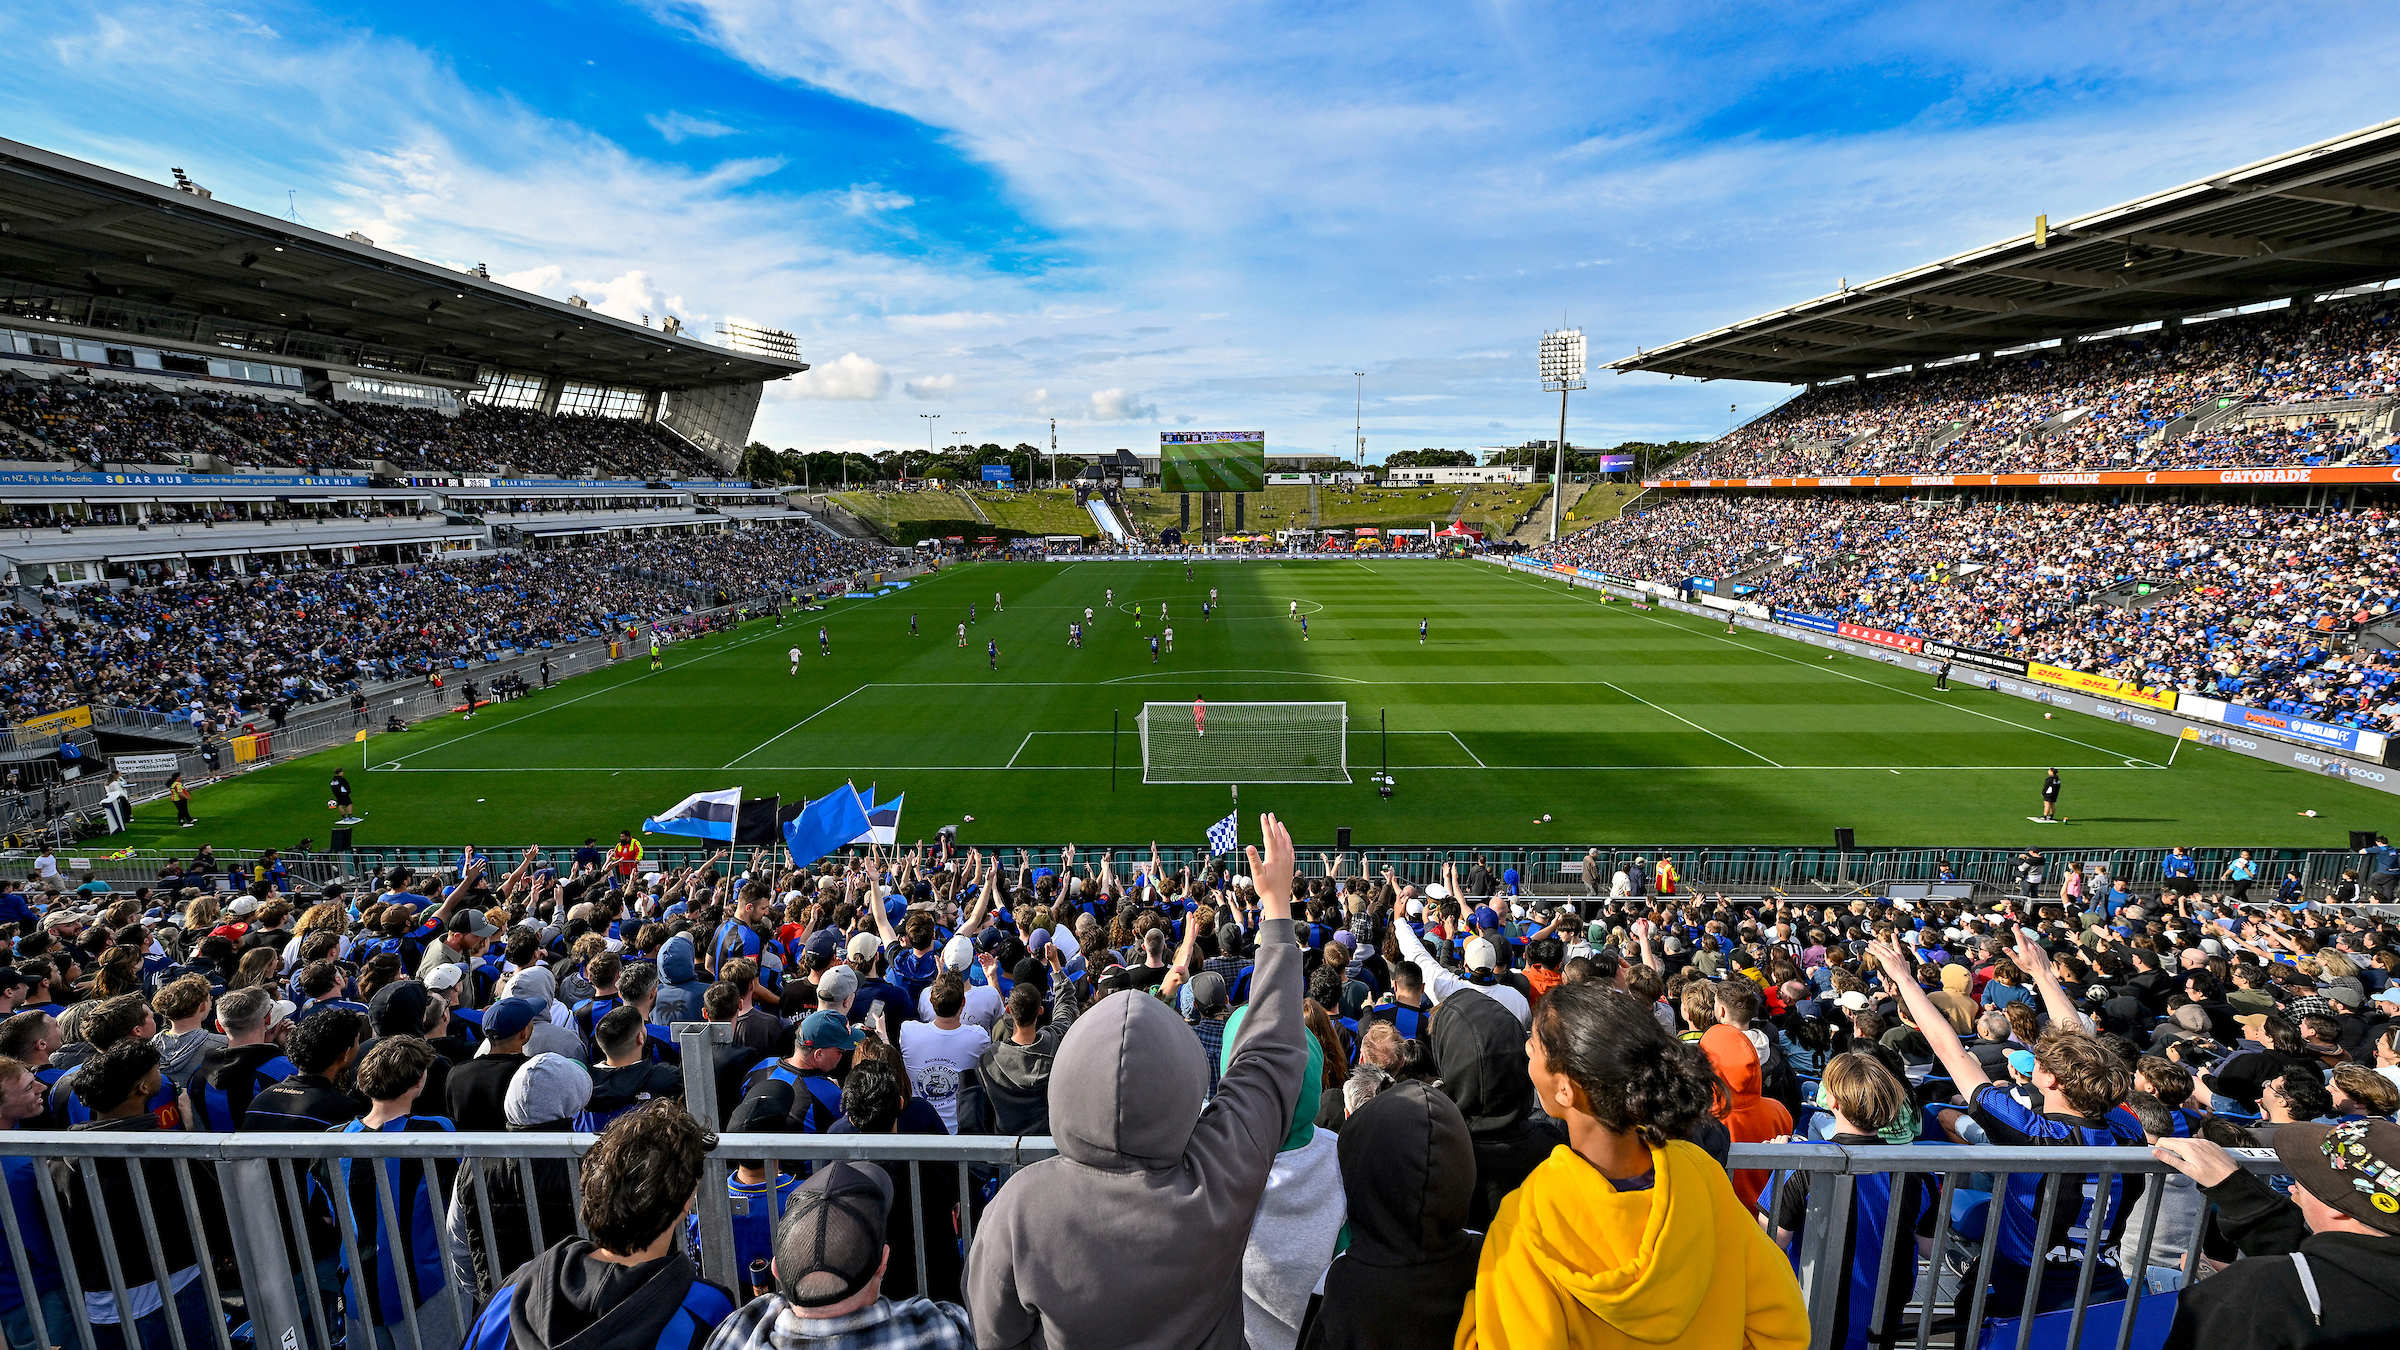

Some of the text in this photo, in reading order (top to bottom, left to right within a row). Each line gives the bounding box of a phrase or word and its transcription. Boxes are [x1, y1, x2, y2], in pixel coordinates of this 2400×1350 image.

[12, 475, 27, 483] NZ,
[29, 475, 41, 485] Fiji
[51, 475, 65, 483] the
[66, 475, 93, 483] Pacific
[158, 476, 182, 484] HUB
[192, 476, 210, 484] Score
[334, 478, 352, 486] HUB
[1746, 479, 1772, 487] GATORADE
[1818, 478, 1851, 486] GATORADE
[1874, 477, 1880, 486] G
[1911, 476, 1955, 486] GATORADE
[1990, 475, 1998, 485] G
[2038, 473, 2100, 485] GATORADE
[2146, 472, 2156, 484] G
[2220, 469, 2312, 483] GATORADE
[1827, 639, 1856, 651] REAL GOOD
[1869, 649, 1880, 657] REAL
[1933, 644, 2025, 672] SNAP SIMPLY BETTER CAR RENTAL
[1916, 660, 1930, 669] REAL
[1974, 674, 2018, 691] REAL GOOD
[2037, 668, 2163, 702] DHL DHL DHL
[2021, 686, 2072, 705] REAL GOOD
[2096, 704, 2156, 726] REAL GOOD
[2244, 710, 2287, 730] betcha
[2300, 722, 2351, 742] AUCKLAND FC
[2228, 736, 2258, 751] GOOD
[2294, 752, 2385, 783] REAL GOOD
[923, 1065, 956, 1077] THE PORT
[282, 1087, 305, 1095] balance
